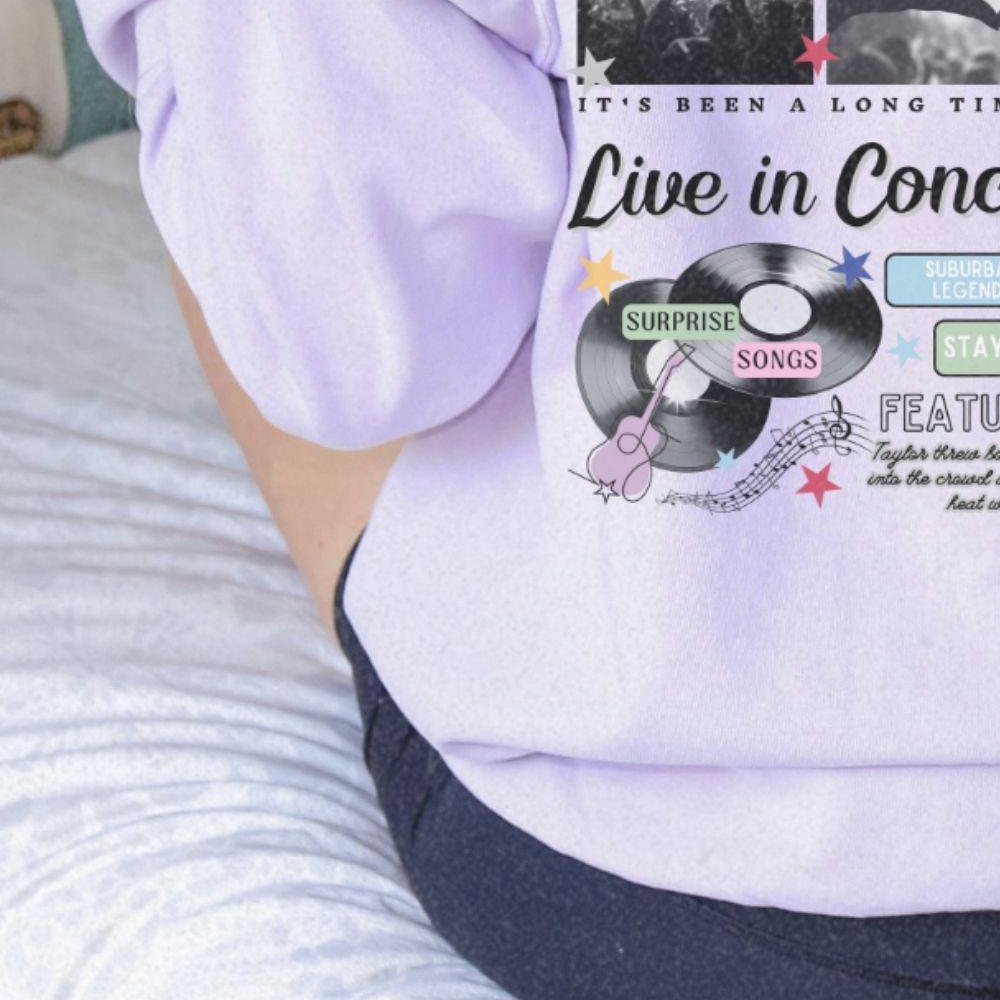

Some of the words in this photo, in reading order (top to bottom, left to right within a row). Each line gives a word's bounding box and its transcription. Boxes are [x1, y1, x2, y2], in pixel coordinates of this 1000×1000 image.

[578, 97, 651, 112] IT'S
[676, 97, 765, 112] BEEN
[789, 97, 806, 112] A
[831, 97, 925, 112] LONG
[567, 143, 728, 229] Live
[750, 155, 817, 216] in
[626, 311, 736, 331] SURPRISE
[737, 350, 818, 369] SONGS
[872, 441, 928, 468] Taylor
[933, 444, 981, 461] threw
[867, 470, 902, 486] into
[906, 470, 931, 485] the
[936, 470, 991, 485] crowd
[945, 494, 984, 511] heat
